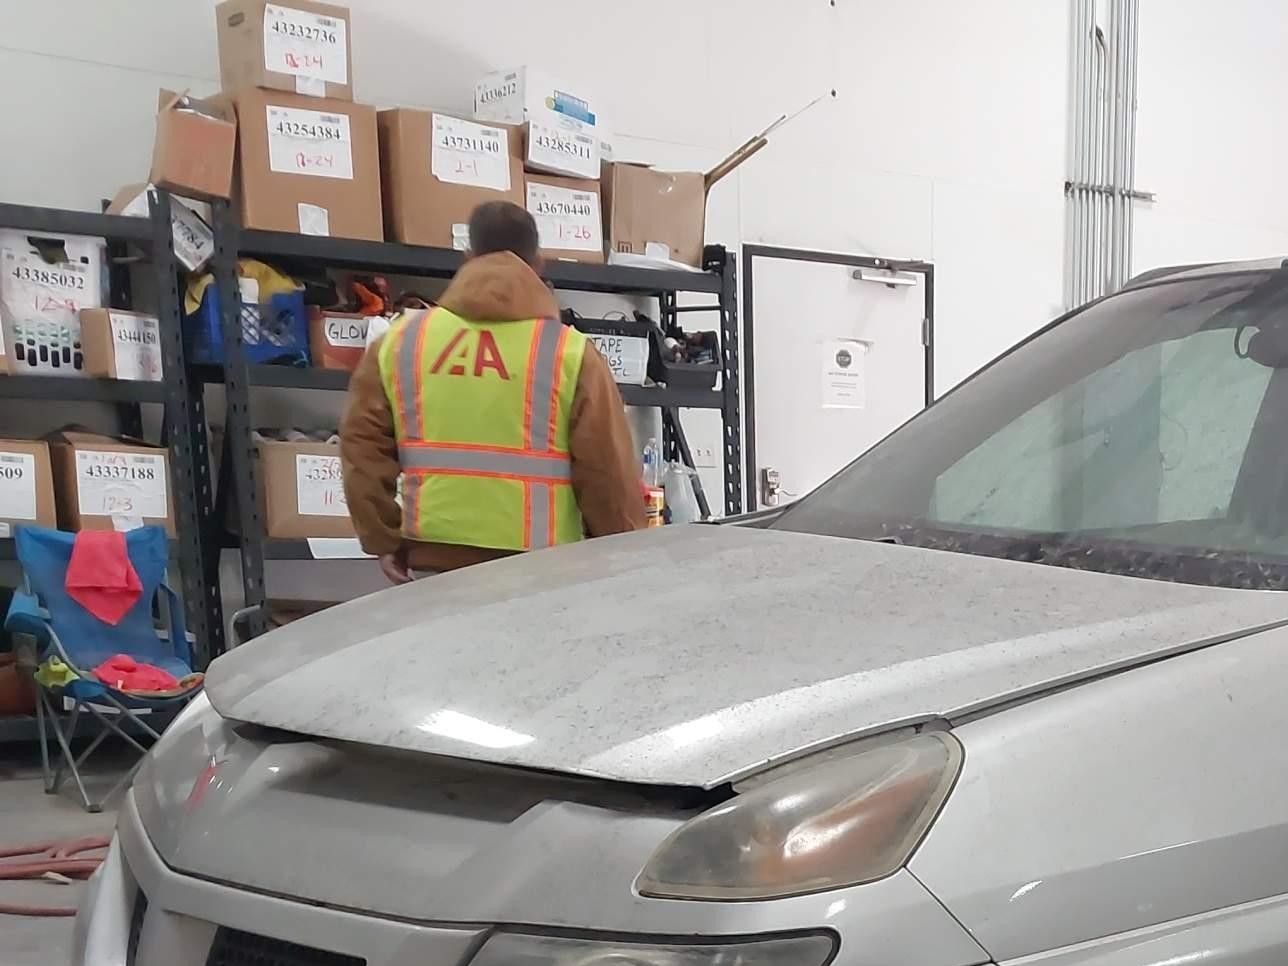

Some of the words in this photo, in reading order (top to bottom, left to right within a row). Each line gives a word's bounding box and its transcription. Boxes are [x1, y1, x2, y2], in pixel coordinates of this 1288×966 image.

[271, 21, 336, 44] 43232736
[276, 121, 340, 140] 43254384
[442, 135, 499, 153] 43731140
[536, 135, 590, 159] 43285311
[536, 202, 591, 216] 43670440
[12, 266, 85, 290] 43385032
[85, 464, 155, 480] 43337188
